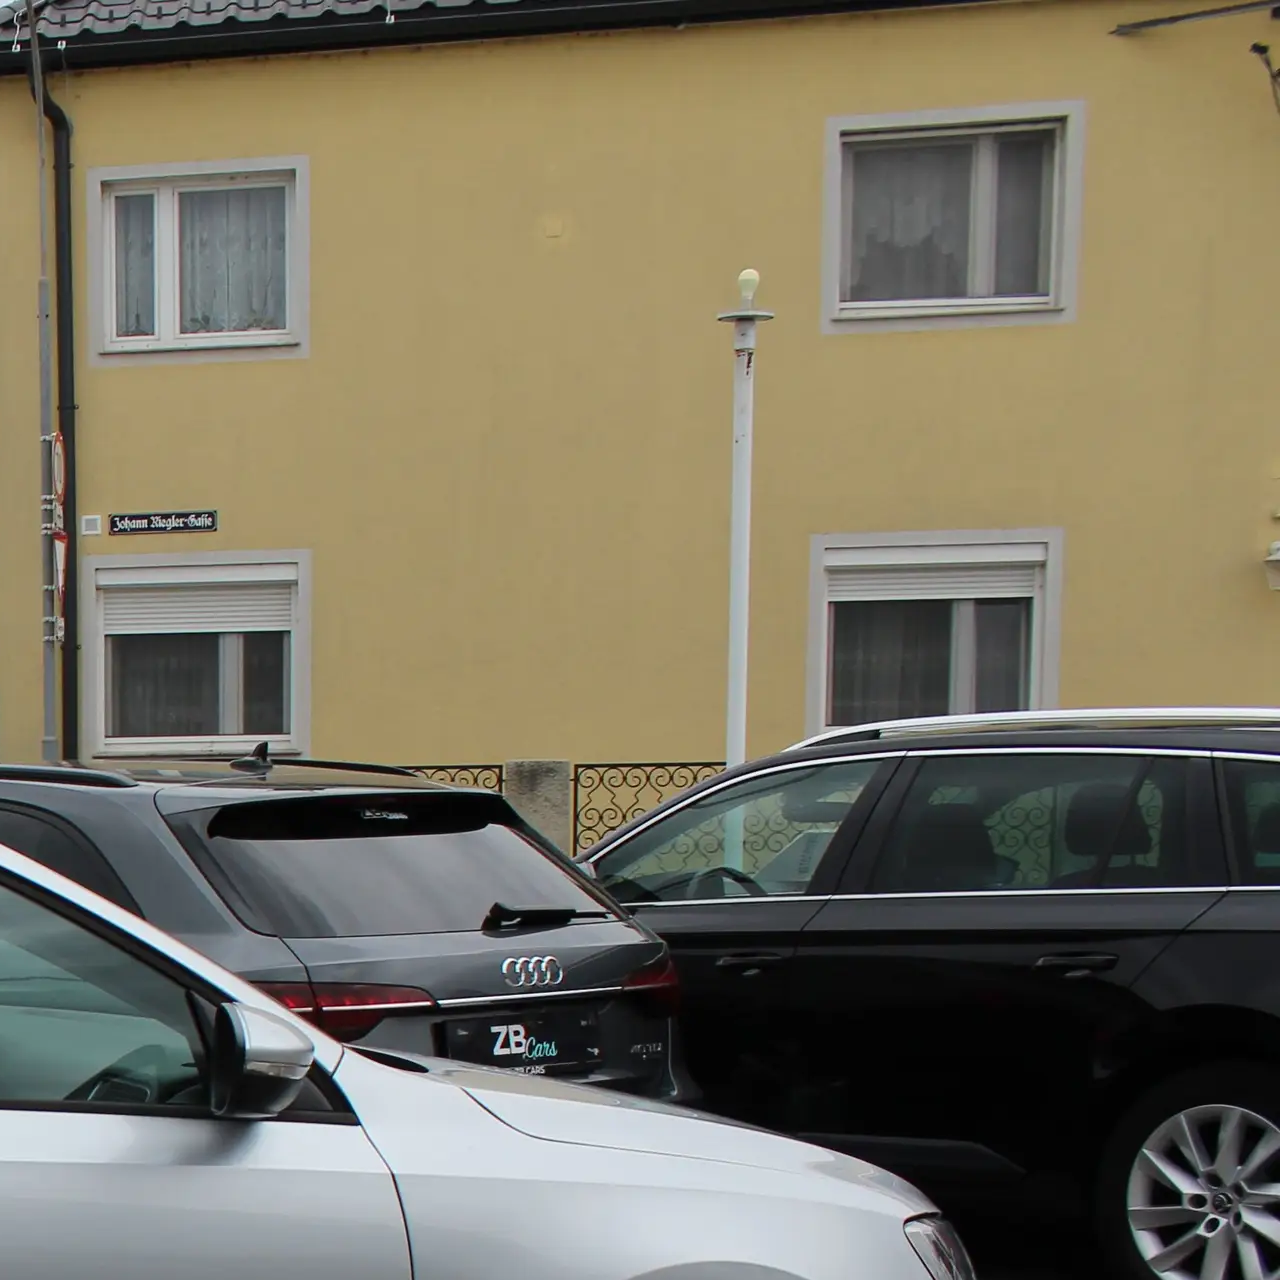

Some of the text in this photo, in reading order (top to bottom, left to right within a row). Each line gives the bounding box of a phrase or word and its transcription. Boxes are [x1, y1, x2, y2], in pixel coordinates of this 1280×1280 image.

[113, 516, 149, 532] Johann
[490, 1024, 558, 1058] ZB Cars
